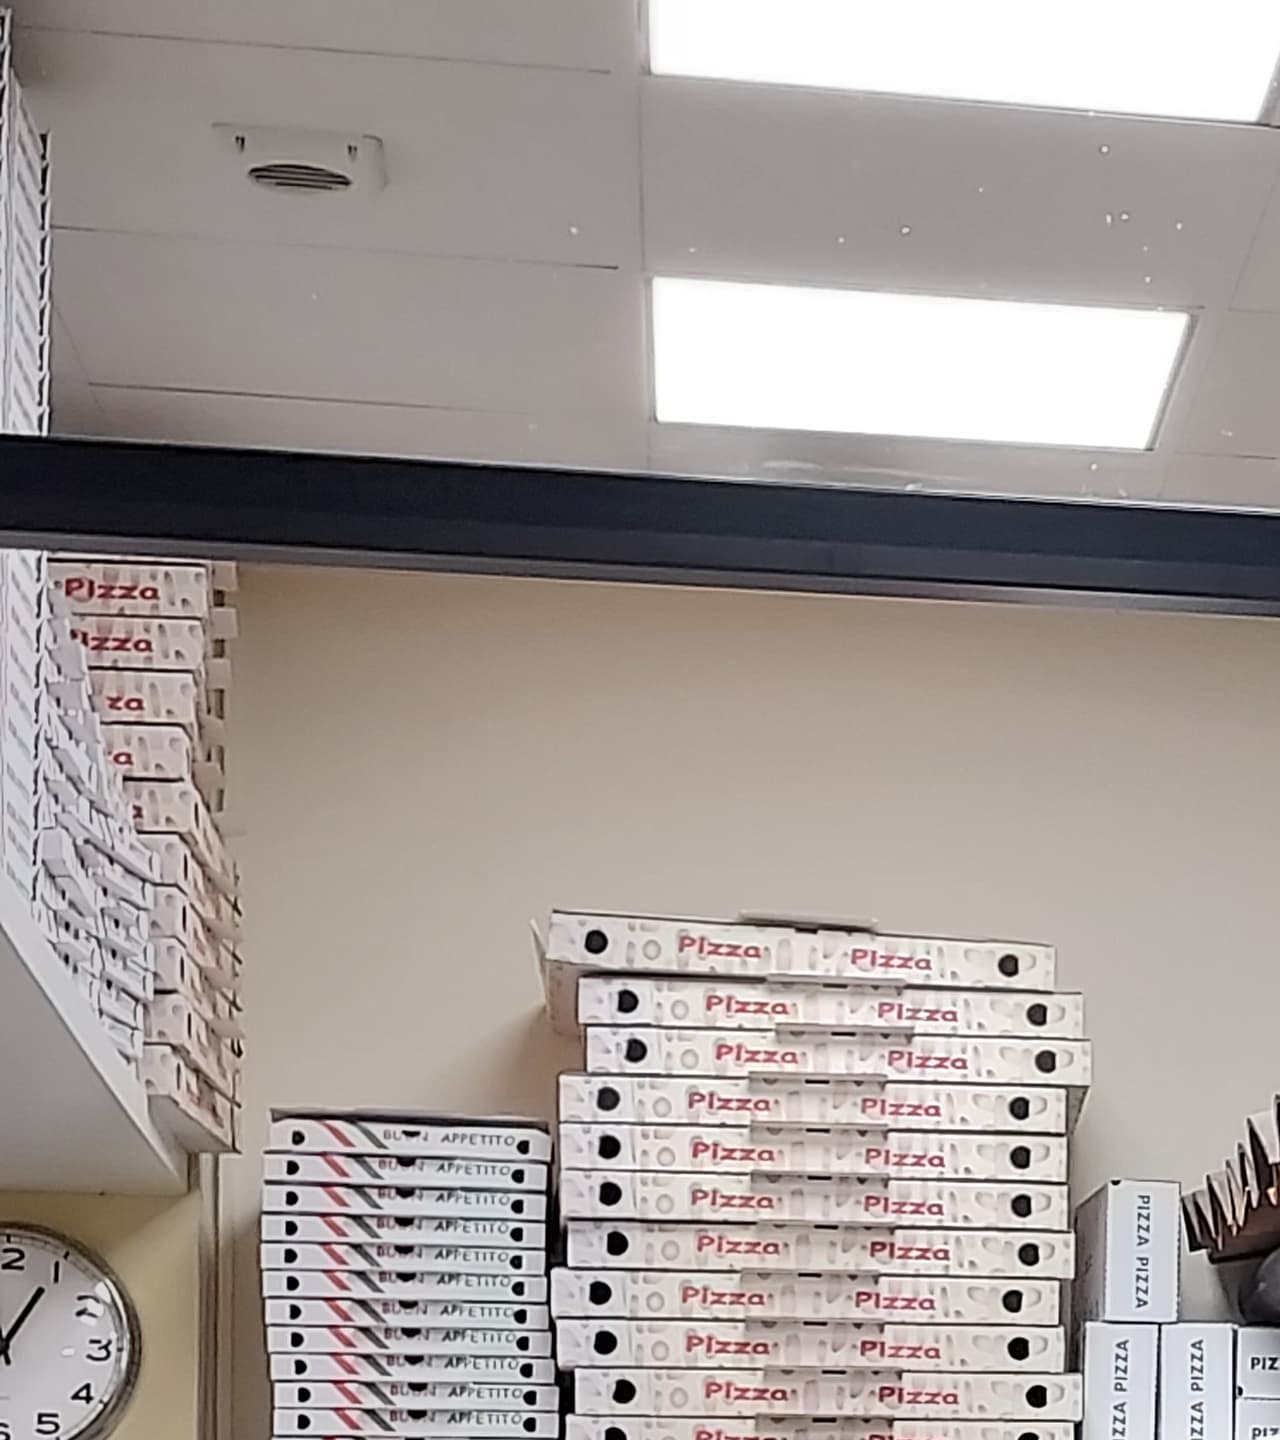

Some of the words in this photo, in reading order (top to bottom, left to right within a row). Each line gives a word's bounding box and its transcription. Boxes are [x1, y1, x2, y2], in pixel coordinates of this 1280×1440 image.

[440, 1133, 515, 1146] APPETITO
[436, 1163, 511, 1176] APPETITO
[435, 1192, 510, 1206] APPETITO
[434, 1220, 509, 1234] APPETITO
[1137, 1195, 1151, 1246] PIZZA
[434, 1249, 509, 1263] APPETITO
[54, 1260, 59, 1284] 1
[437, 1274, 511, 1288] APPETITO
[1136, 1257, 1149, 1308] PIZZA
[440, 1304, 514, 1318] APPETITO
[442, 1330, 516, 1343] APPETITO
[86, 1338, 112, 1362] 3
[444, 1357, 519, 1370] APPETITO
[1114, 1340, 1130, 1392] PIZZA
[1191, 1339, 1205, 1392] PIZZA
[71, 1382, 94, 1404] 4
[448, 1386, 523, 1399] APPETITO
[35, 1412, 60, 1435] 5
[447, 1411, 522, 1425] APPETITO
